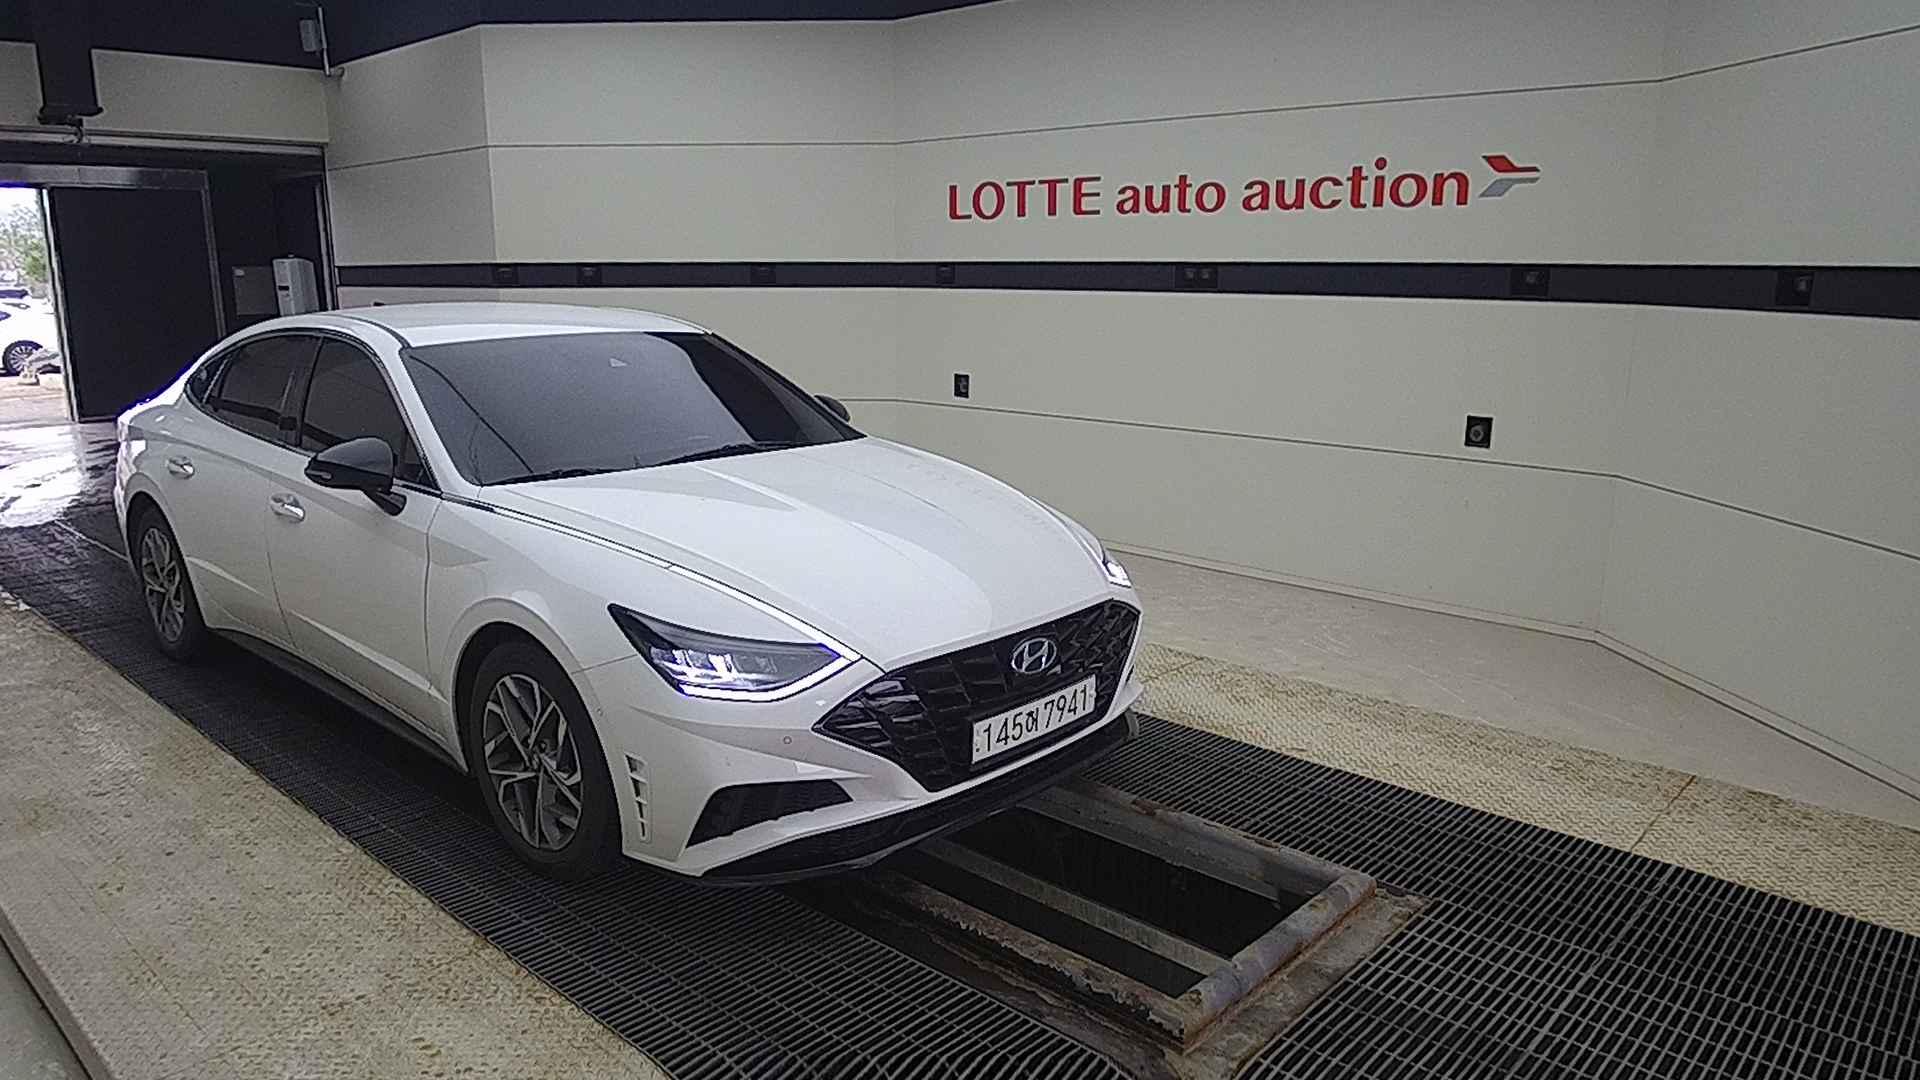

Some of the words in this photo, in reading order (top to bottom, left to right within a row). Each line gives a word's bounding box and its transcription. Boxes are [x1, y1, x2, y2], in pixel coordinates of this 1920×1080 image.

[949, 176, 1102, 220] LOTTE
[1116, 174, 1227, 215] auto
[1242, 157, 1470, 211] auction
[1043, 683, 1088, 729] 7941
